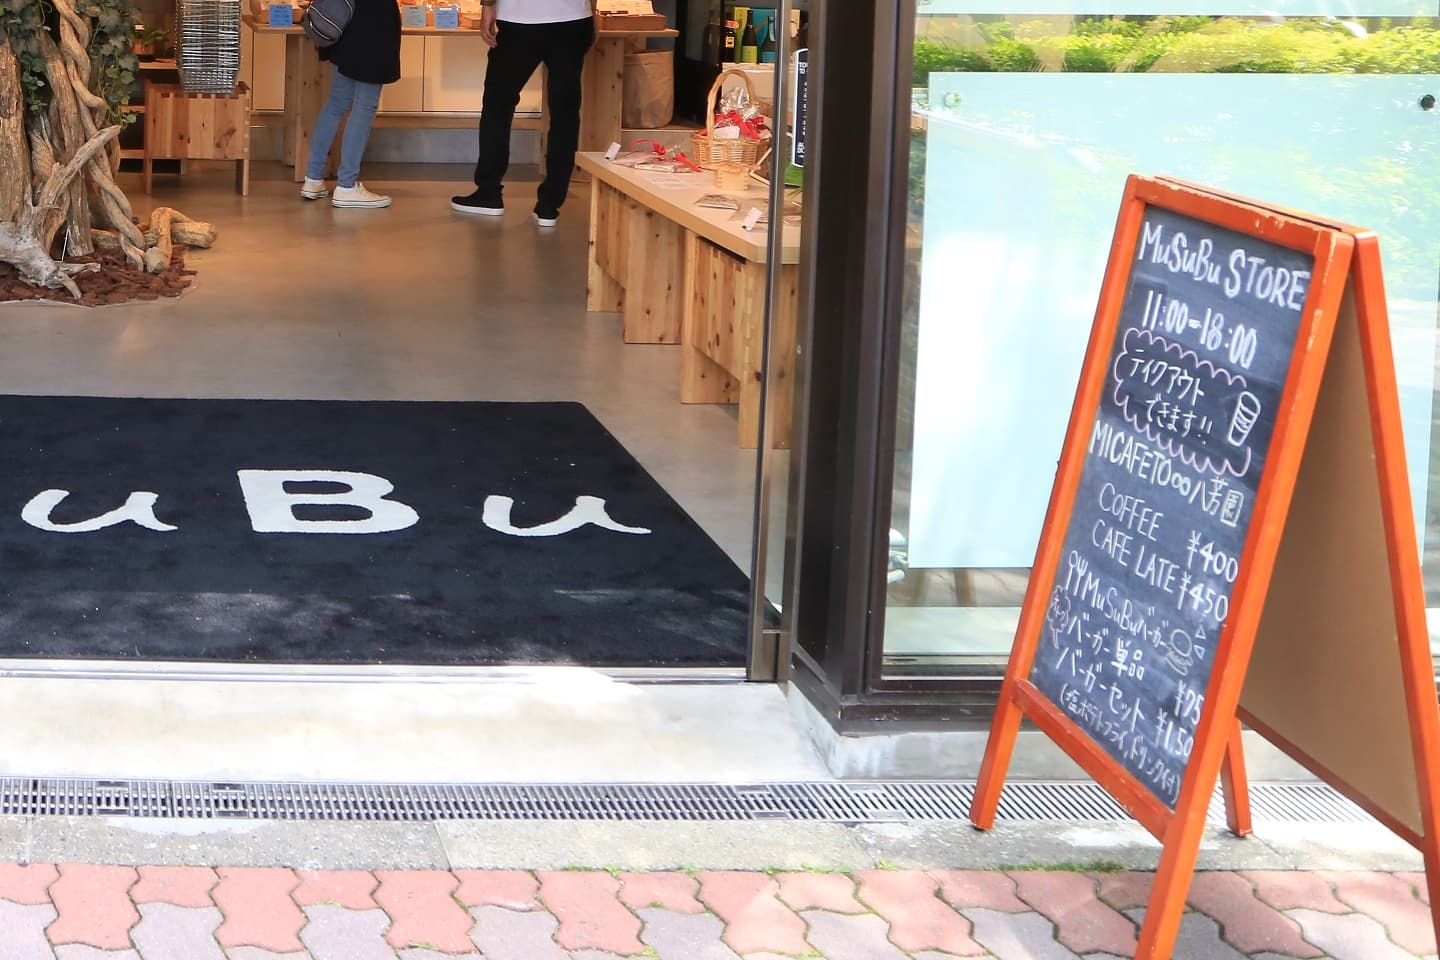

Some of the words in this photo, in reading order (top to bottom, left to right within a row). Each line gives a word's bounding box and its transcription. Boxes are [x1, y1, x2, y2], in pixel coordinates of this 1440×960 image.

[1138, 221, 1220, 284] MuSuBu
[1224, 248, 1312, 311] STORE
[1129, 348, 1205, 406] テイクアウト
[1099, 483, 1164, 542] COFFEE
[1092, 520, 1134, 567] CAFE
[1135, 545, 1180, 592] LATE
[1186, 530, 1239, 583] ¥400
[1178, 571, 1229, 622] ¥450
